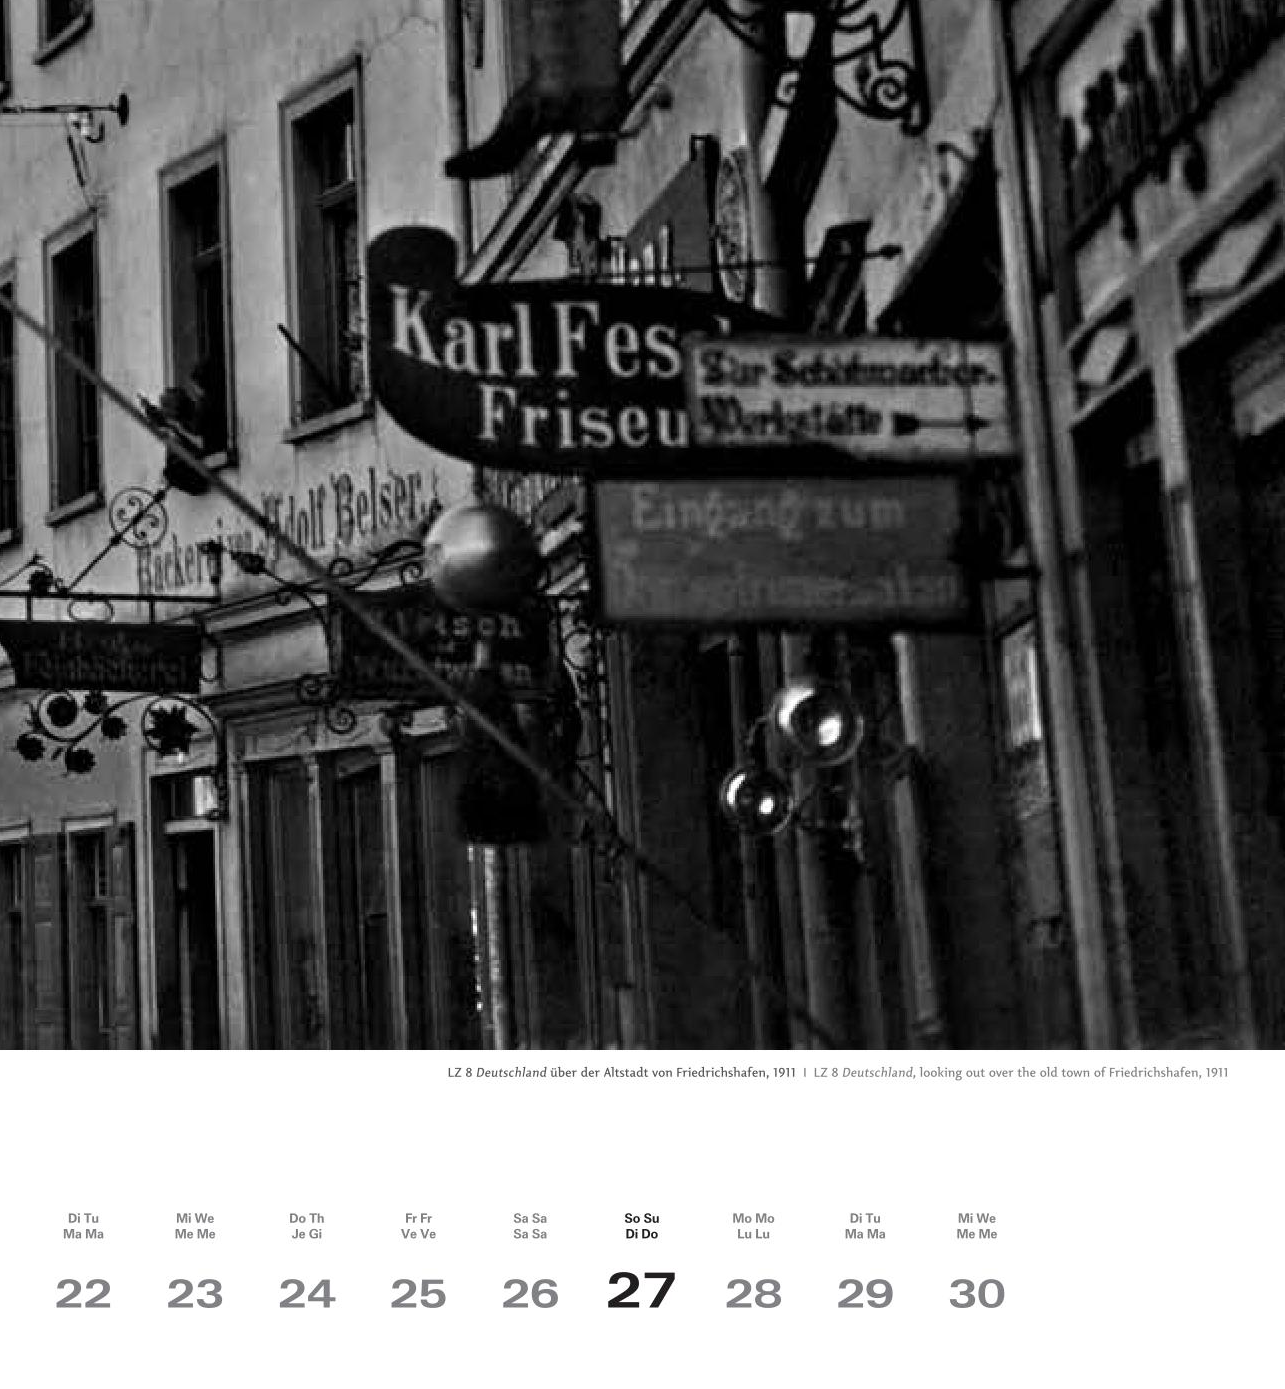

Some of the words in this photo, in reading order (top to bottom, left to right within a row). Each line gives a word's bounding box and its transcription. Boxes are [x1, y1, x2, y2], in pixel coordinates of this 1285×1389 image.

[389, 283, 538, 378] Karl
[551, 300, 681, 378] Fes
[478, 382, 690, 449] Friseu
